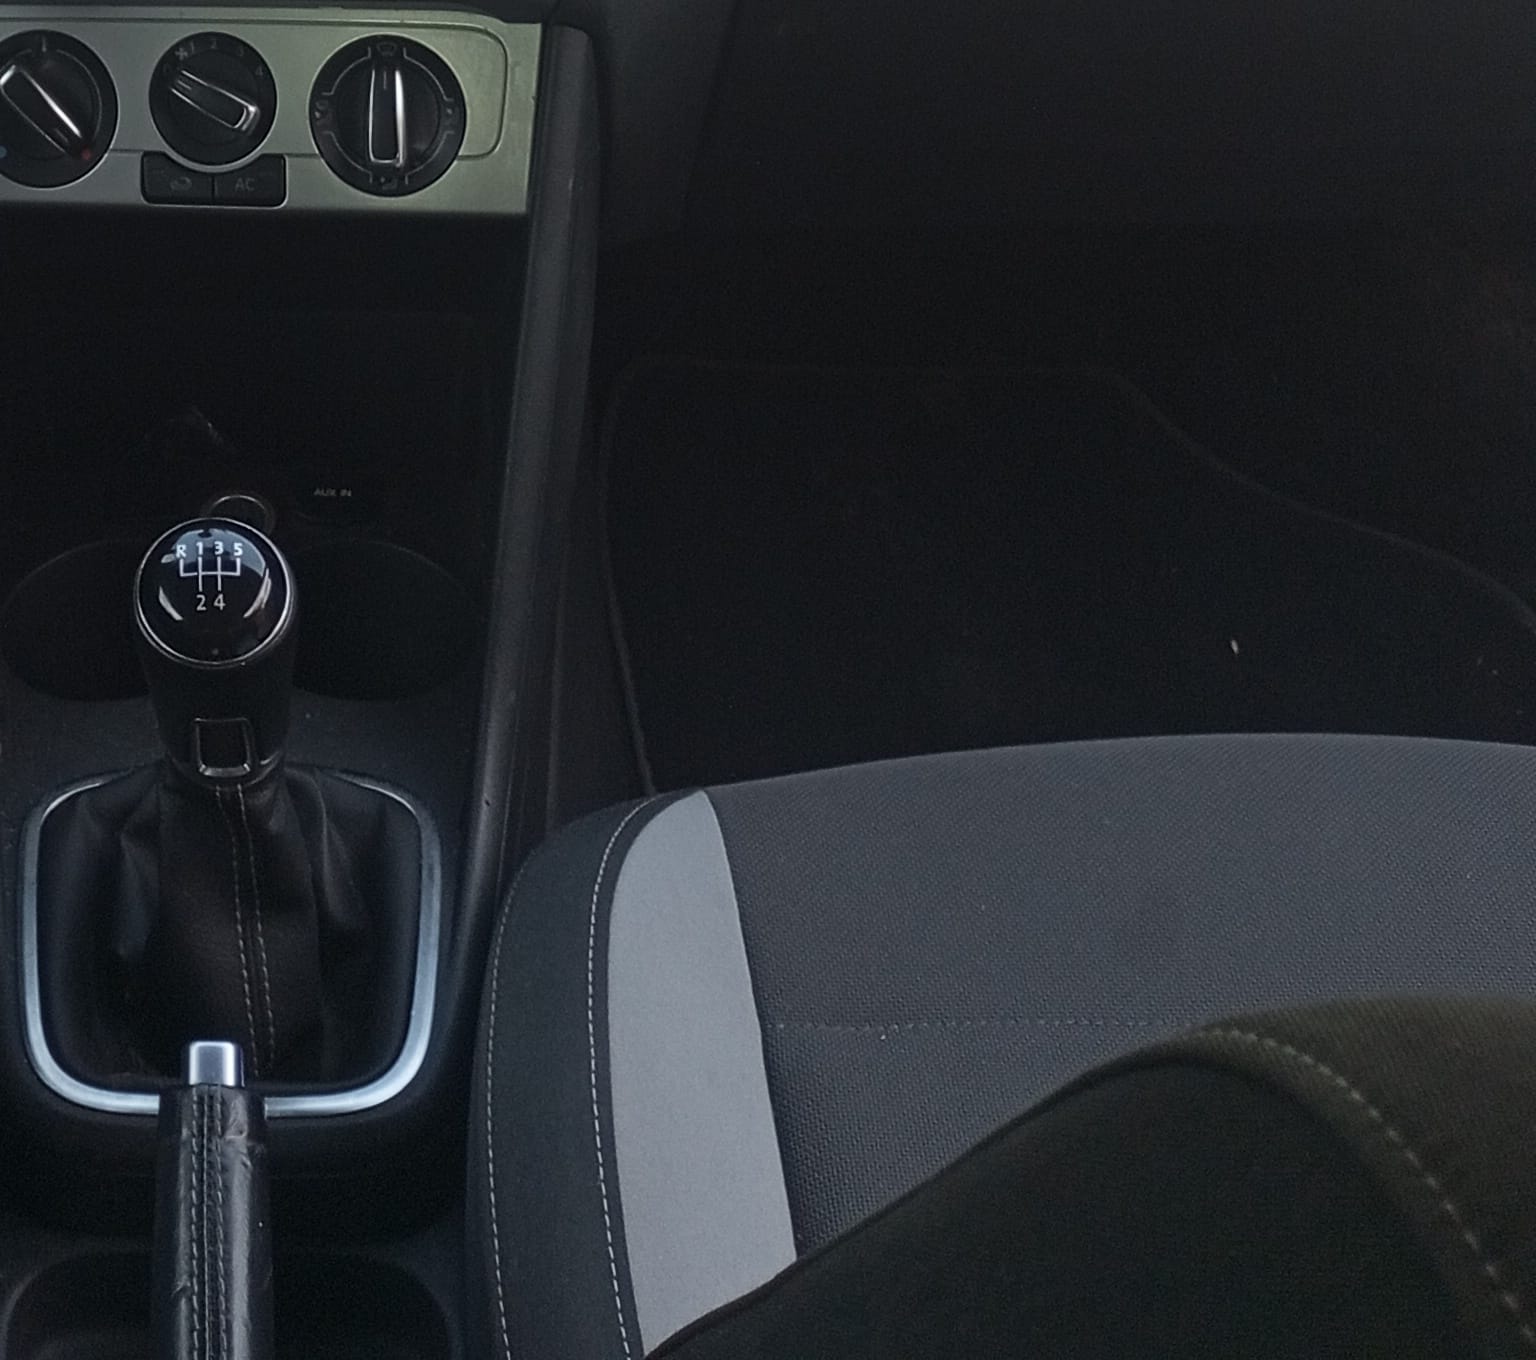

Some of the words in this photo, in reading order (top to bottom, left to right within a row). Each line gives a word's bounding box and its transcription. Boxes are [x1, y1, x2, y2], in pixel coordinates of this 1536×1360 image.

[234, 177, 256, 191] AC
[175, 544, 187, 558] R
[196, 541, 204, 556] 1
[214, 541, 224, 556] 3
[233, 542, 244, 557] 5
[196, 594, 207, 612] 2
[214, 594, 226, 611] 4
